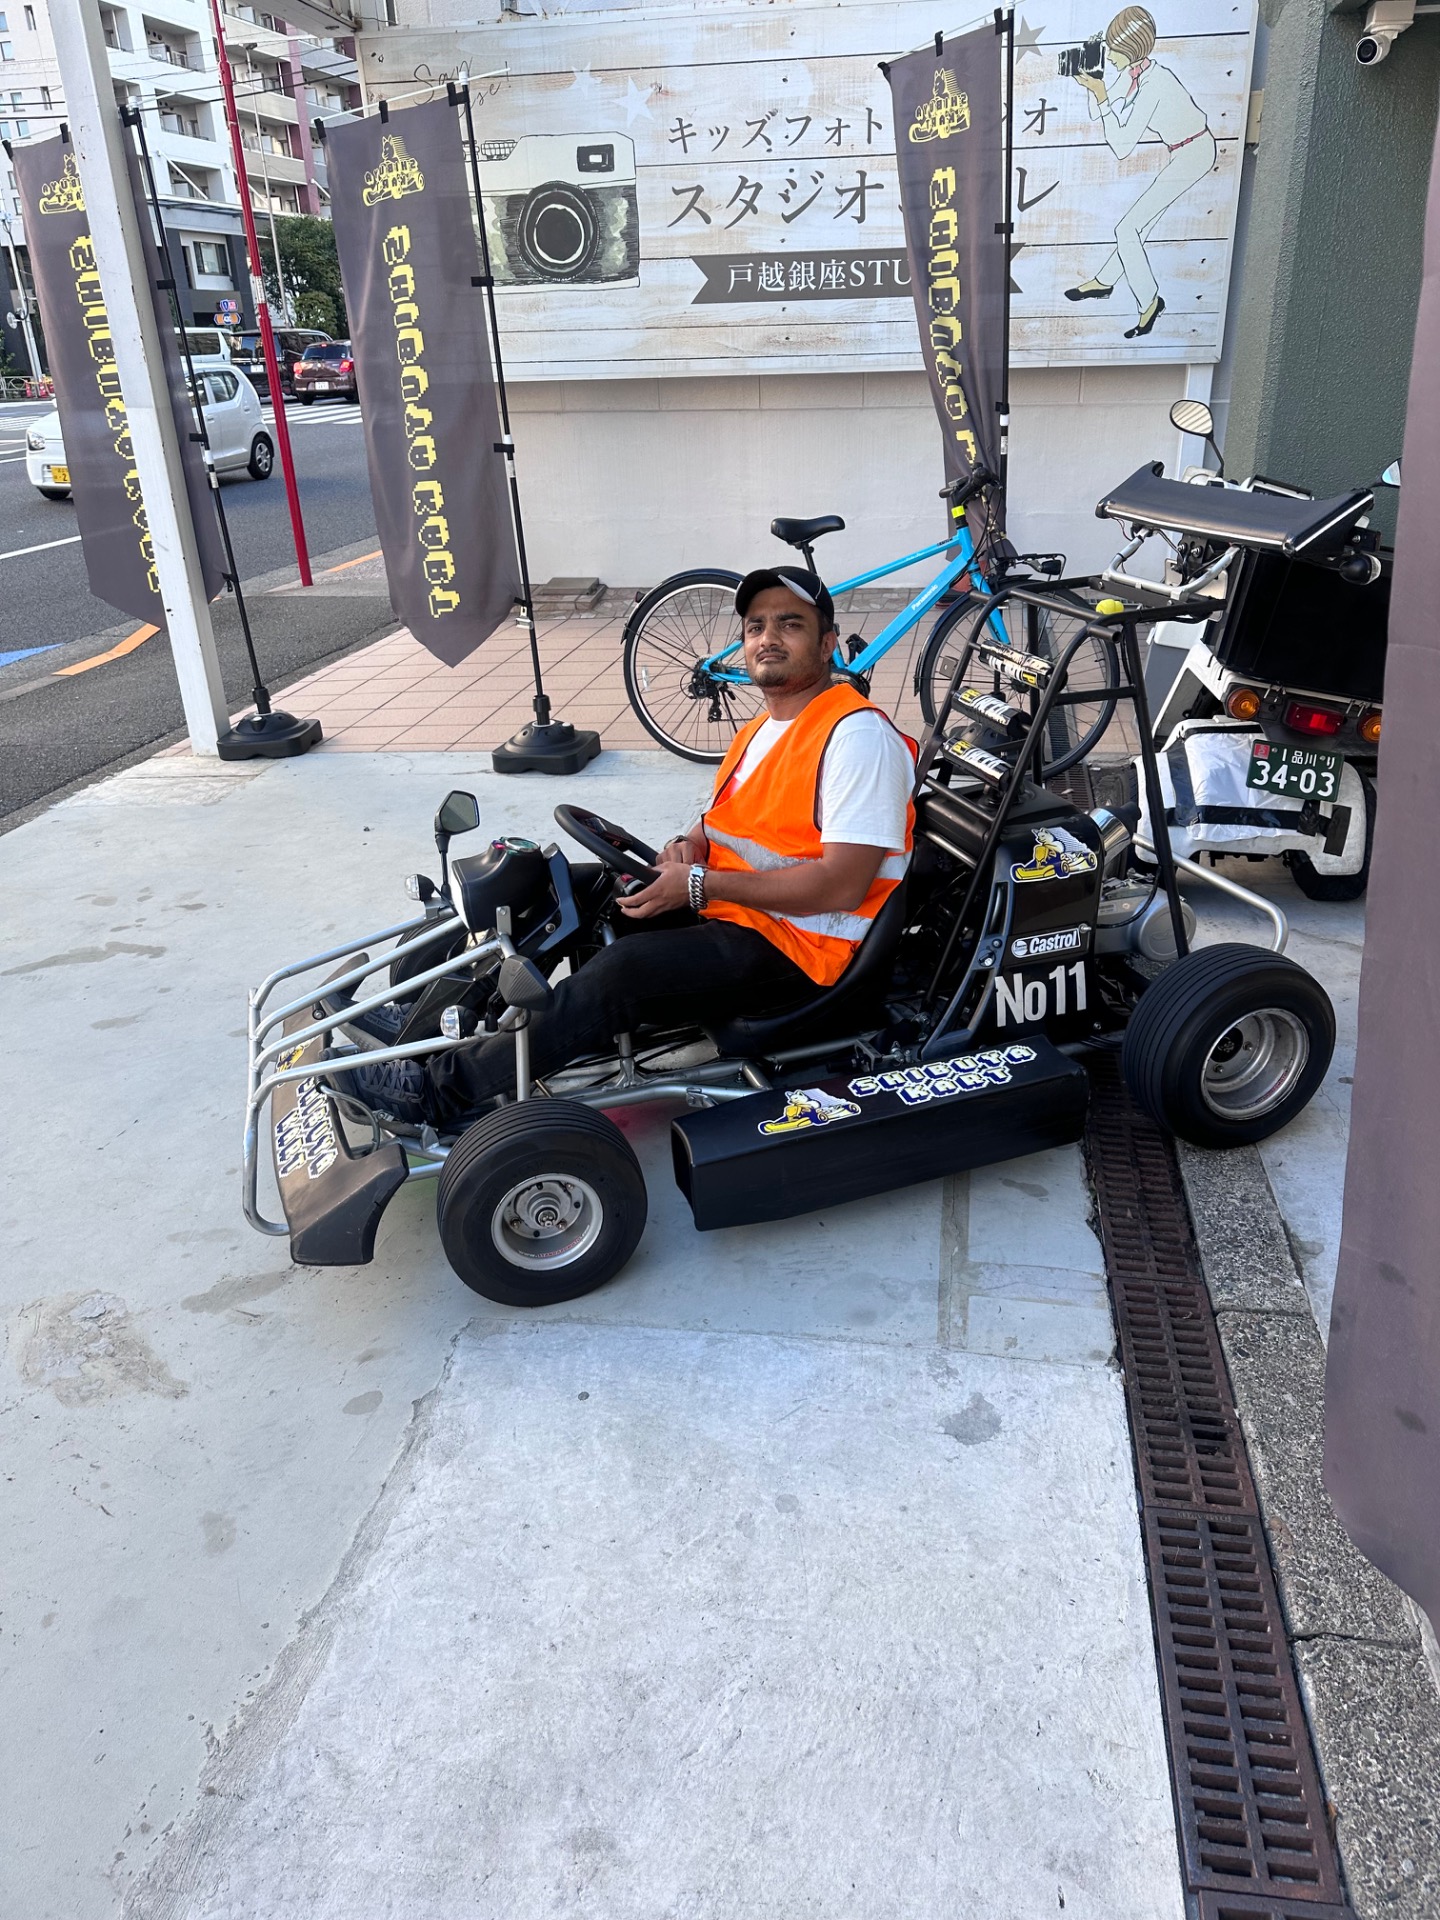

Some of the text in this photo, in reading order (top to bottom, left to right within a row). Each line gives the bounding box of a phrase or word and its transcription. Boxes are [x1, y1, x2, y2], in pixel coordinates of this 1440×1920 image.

[728, 258, 912, 294] 戸越銀座STU
[911, 584, 938, 611] Panasonic
[1252, 760, 1335, 797] 34-03
[1029, 931, 1077, 954] Castrol
[848, 1045, 1037, 1097] SHIBUYA
[896, 1066, 1013, 1106] KART
[275, 1107, 308, 1178] KART
